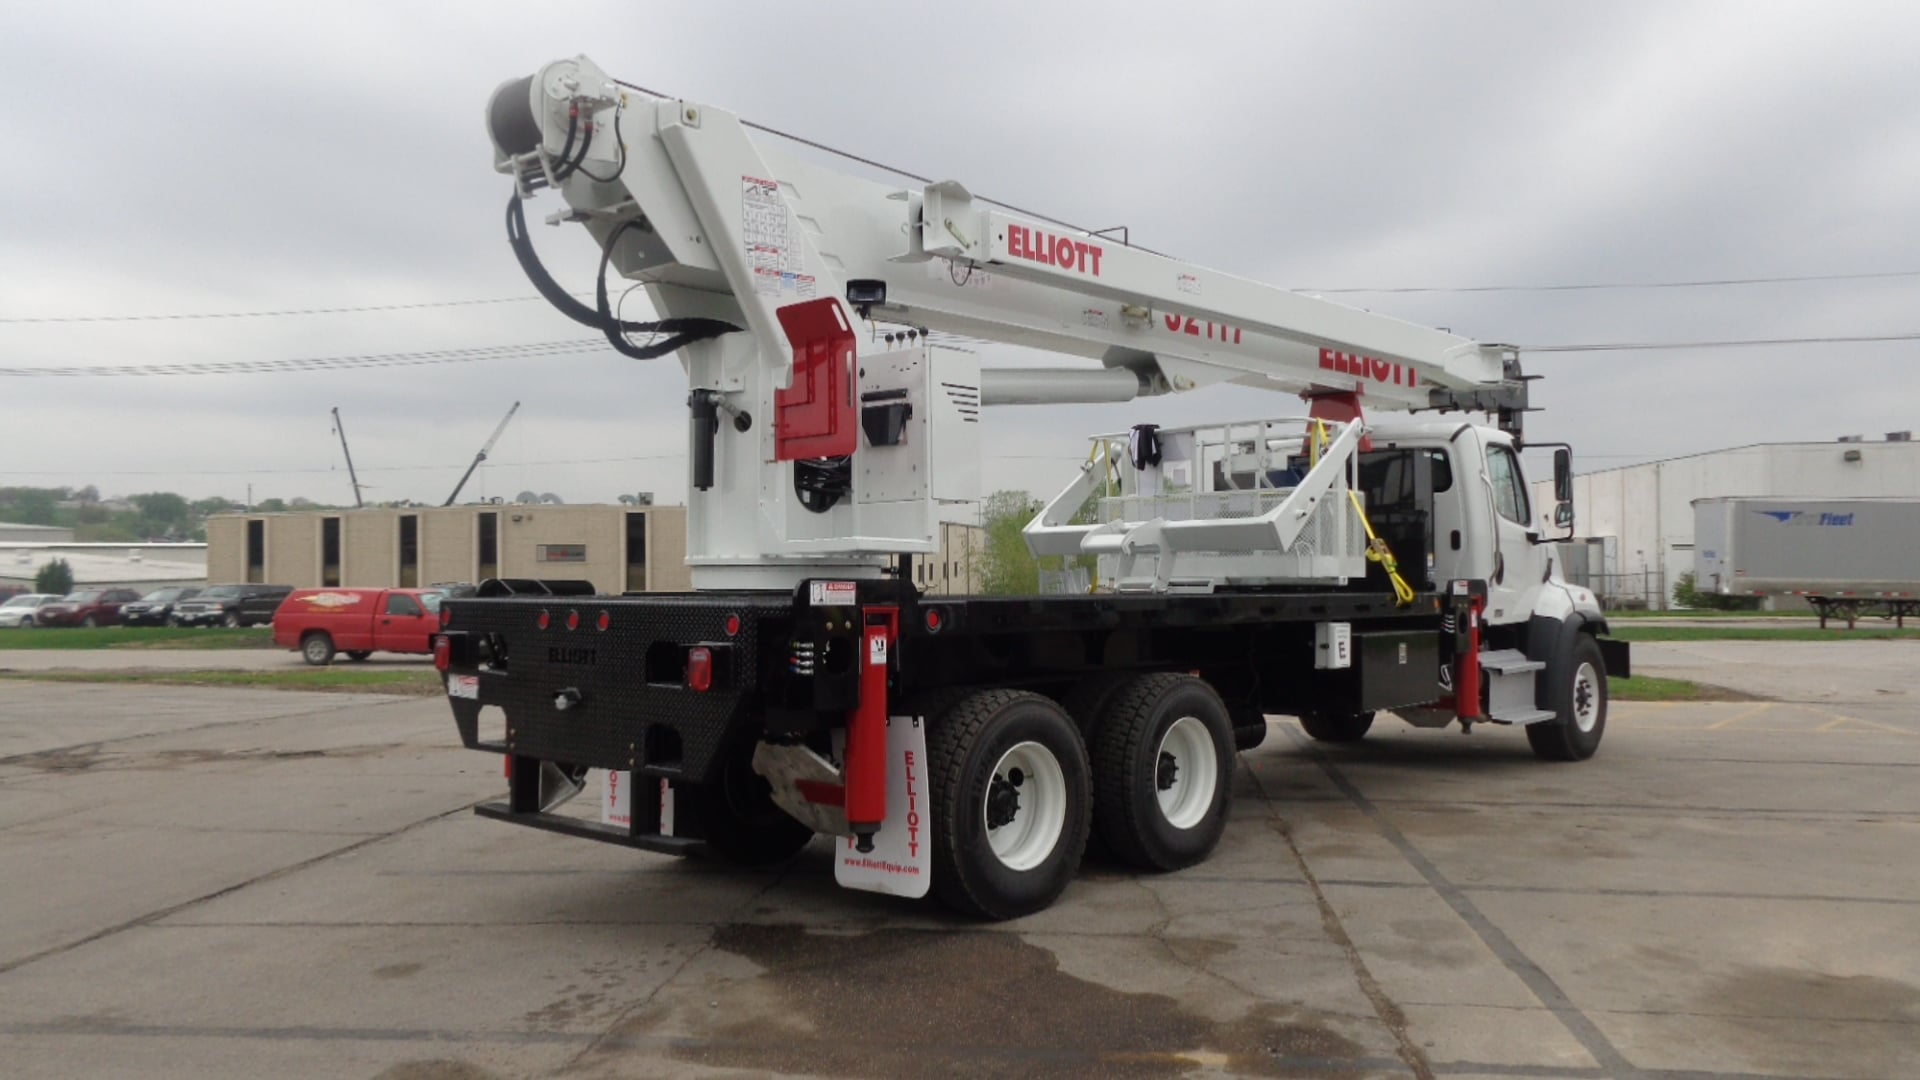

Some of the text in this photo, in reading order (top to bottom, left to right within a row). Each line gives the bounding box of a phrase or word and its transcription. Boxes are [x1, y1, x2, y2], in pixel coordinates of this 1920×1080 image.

[1008, 224, 1102, 277] ELLIOTT
[1318, 348, 1416, 388] ELLIOTT
[904, 750, 919, 858] ELLIOTT
